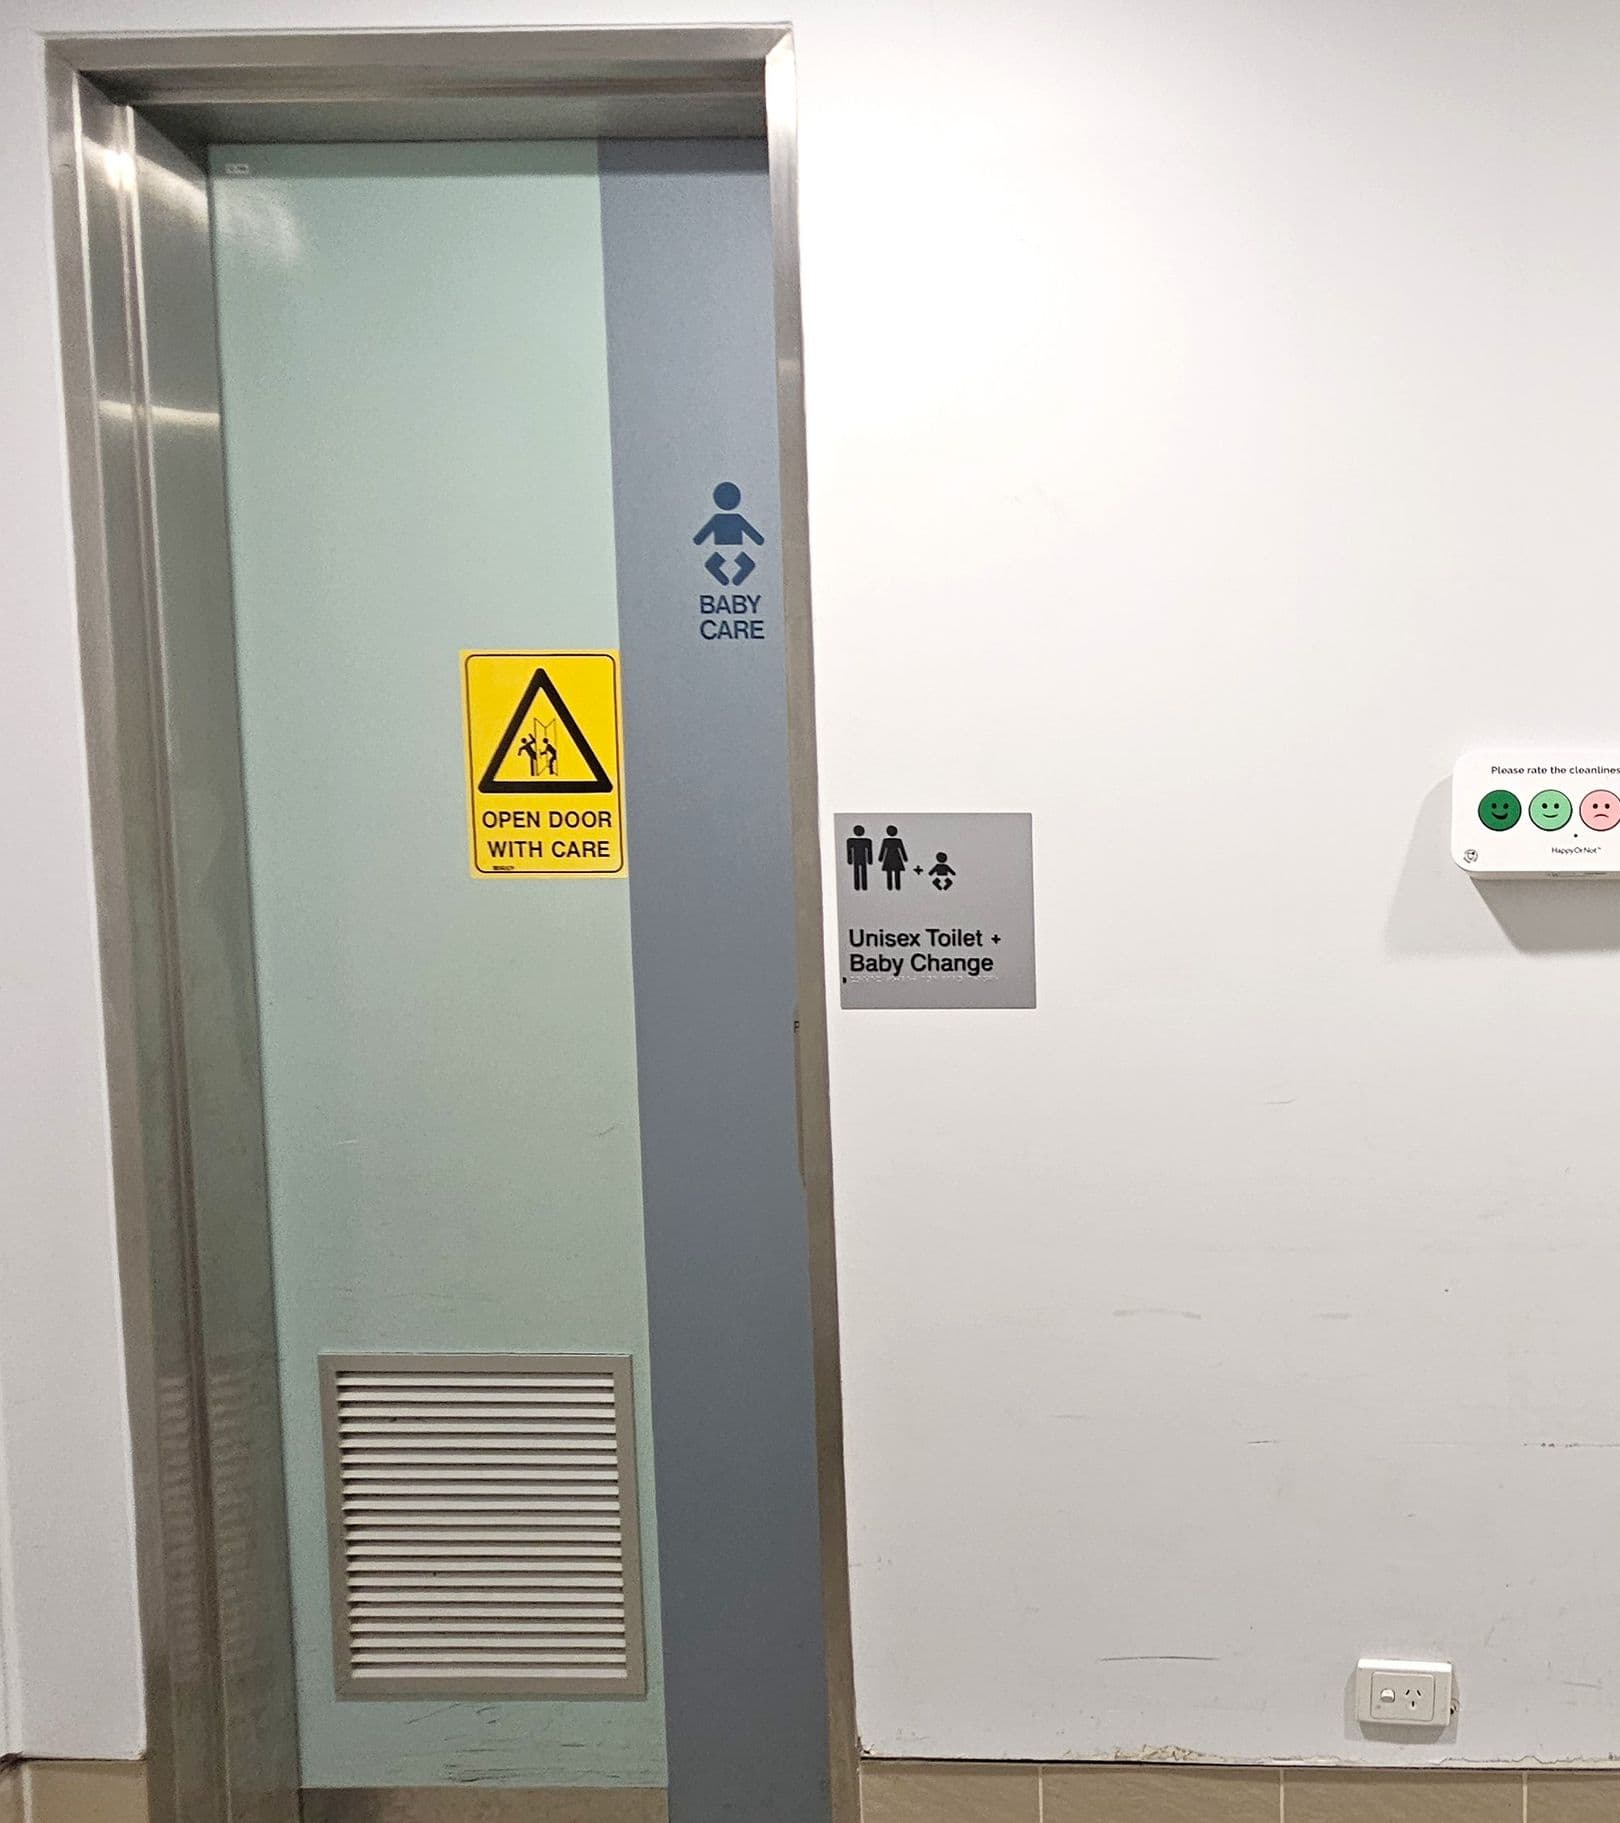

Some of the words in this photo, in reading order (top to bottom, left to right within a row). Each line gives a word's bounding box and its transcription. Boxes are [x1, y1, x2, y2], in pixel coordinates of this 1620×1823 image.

[700, 595, 761, 614] BABY
[700, 620, 765, 640] CARE
[1491, 766, 1524, 774] Please
[1527, 766, 1547, 774] rate
[1550, 766, 1567, 774] the
[482, 811, 540, 828] OPEN
[549, 811, 612, 828] DOOR
[487, 841, 543, 857] WITH
[551, 841, 610, 858] CARE
[849, 928, 920, 947] Unisex
[925, 928, 983, 947] Toilet
[850, 953, 904, 976] Baby
[910, 953, 994, 976] Change
